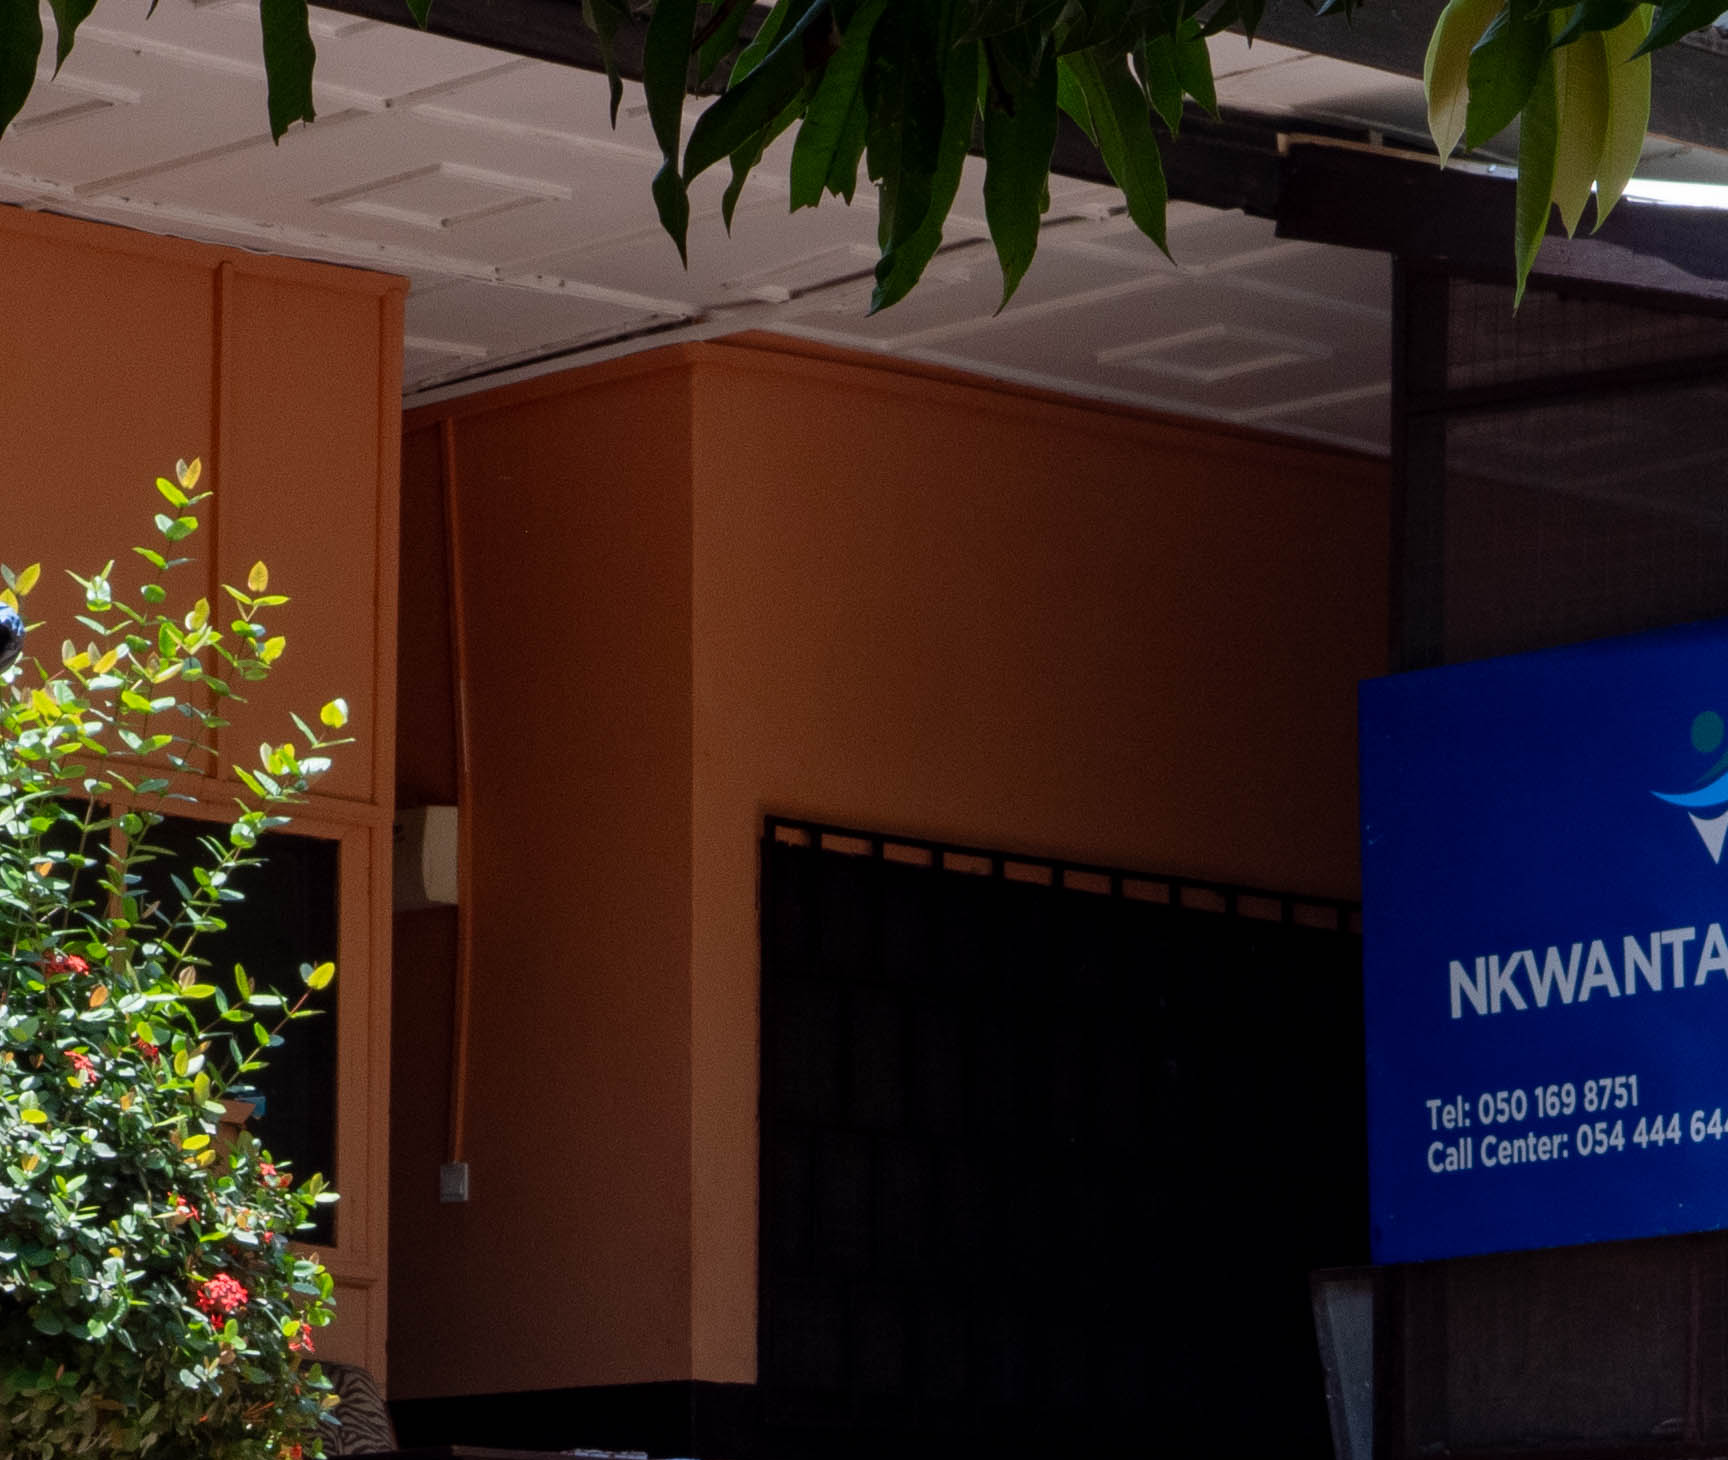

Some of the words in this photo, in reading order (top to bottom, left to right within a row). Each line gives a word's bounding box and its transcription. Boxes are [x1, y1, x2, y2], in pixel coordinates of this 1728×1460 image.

[1426, 1095, 1470, 1130] Tel:
[1478, 1089, 1528, 1125] 050
[1535, 1082, 1576, 1118] 169
[1584, 1074, 1638, 1113] 8751
[1427, 1137, 1472, 1173] Call
[1480, 1132, 1569, 1167] Center:
[1576, 1120, 1625, 1156] 054
[1633, 1113, 1681, 1148] 444
